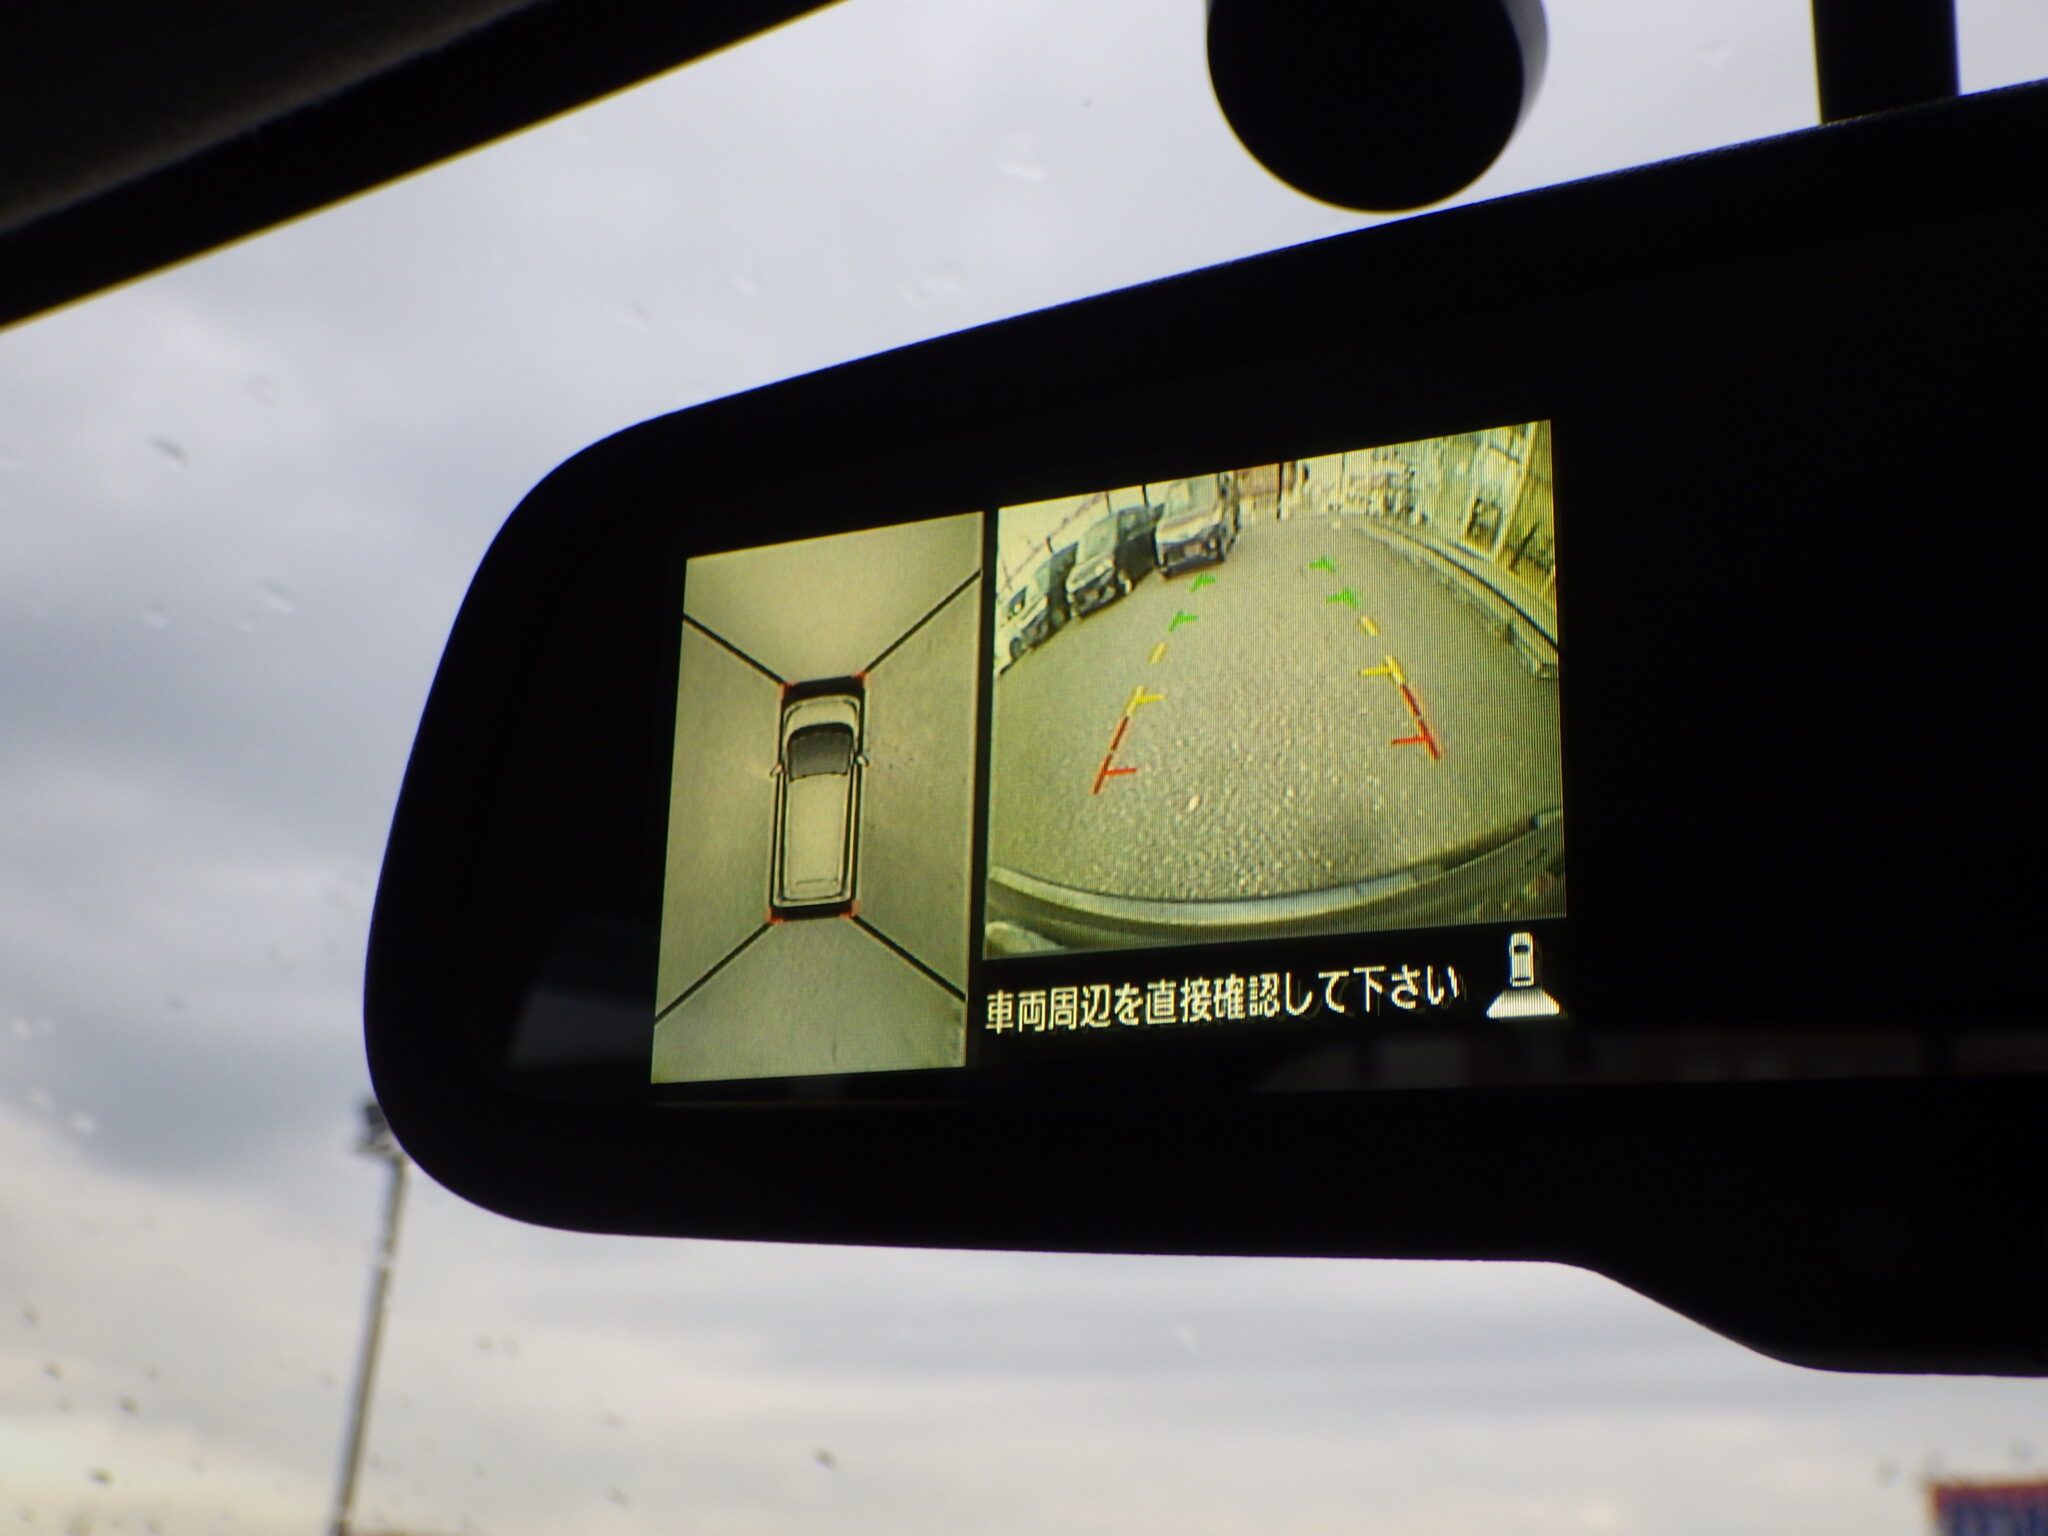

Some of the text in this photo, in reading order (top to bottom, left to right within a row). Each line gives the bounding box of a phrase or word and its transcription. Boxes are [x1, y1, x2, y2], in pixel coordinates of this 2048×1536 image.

[985, 963, 1459, 1034] 車両周辺を直接確認して下さい
